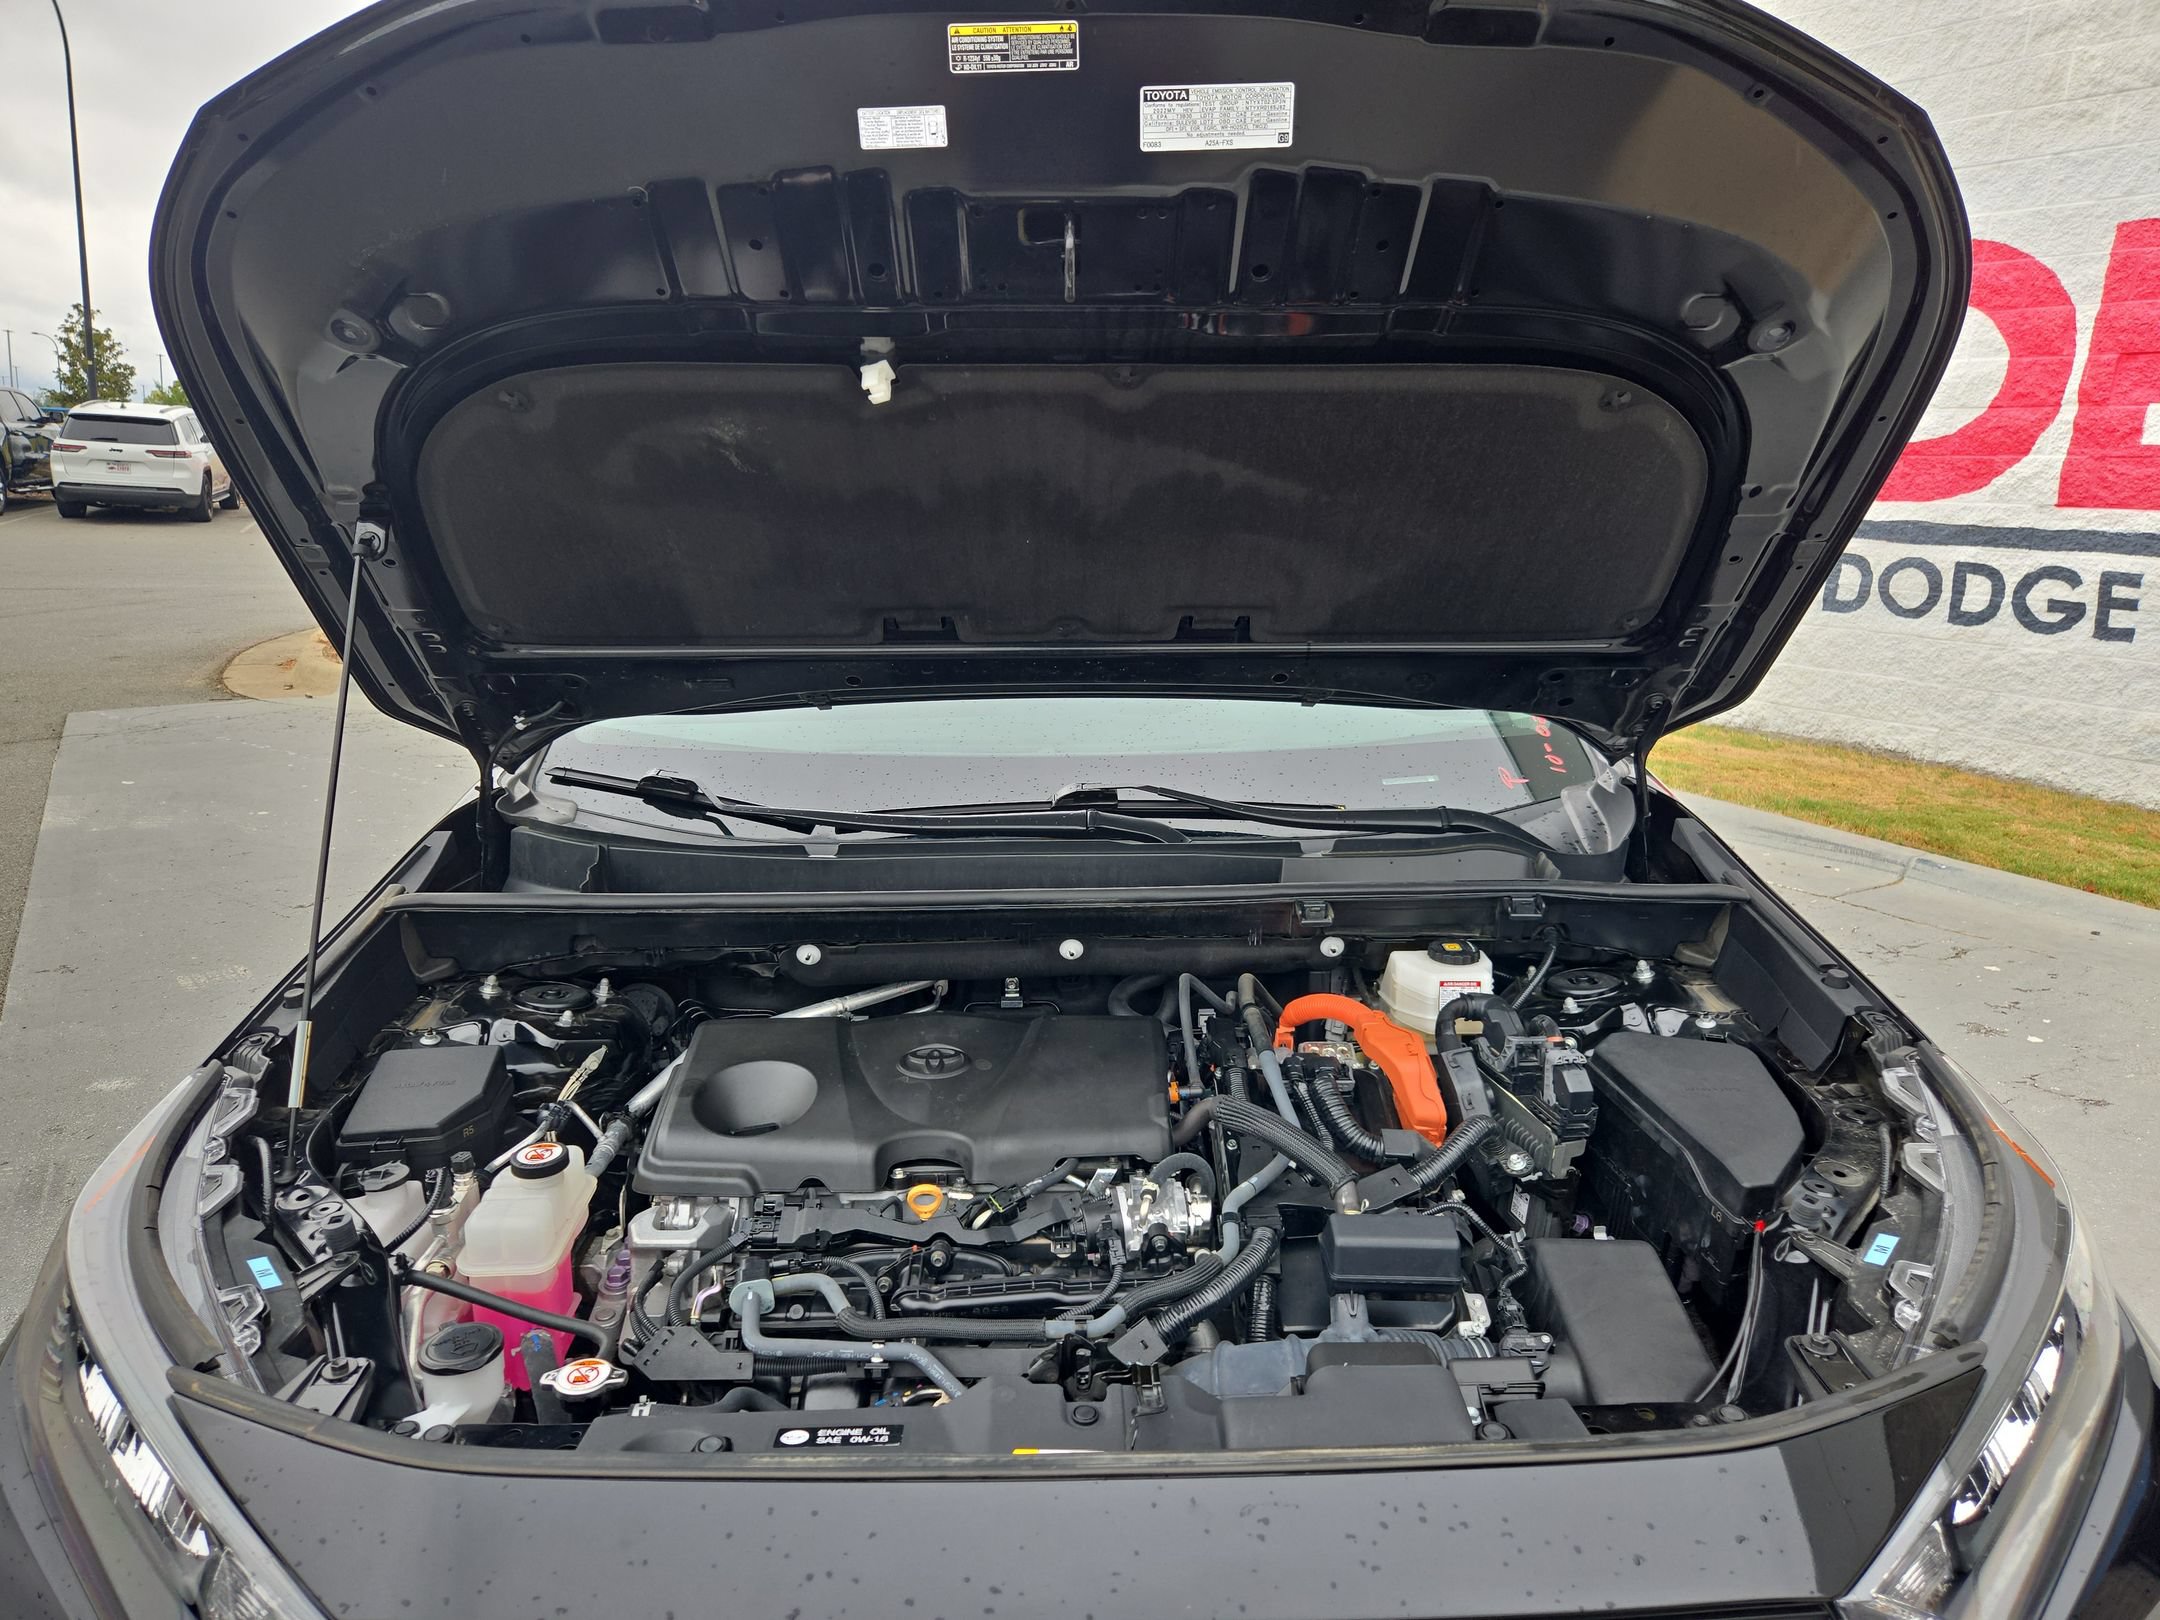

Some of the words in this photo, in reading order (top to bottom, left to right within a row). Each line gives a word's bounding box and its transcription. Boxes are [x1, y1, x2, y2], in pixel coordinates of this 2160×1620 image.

[1145, 90, 1188, 100] TOYOTA
[1279, 133, 1289, 143] G9
[1822, 553, 2144, 644] DODGE
[463, 1125, 475, 1138] R5
[1711, 1206, 1722, 1222] L6
[817, 1428, 863, 1436] ENGINE
[869, 1427, 890, 1435] OIL
[816, 1436, 842, 1444] SAE
[849, 1435, 890, 1444] 0W-16
